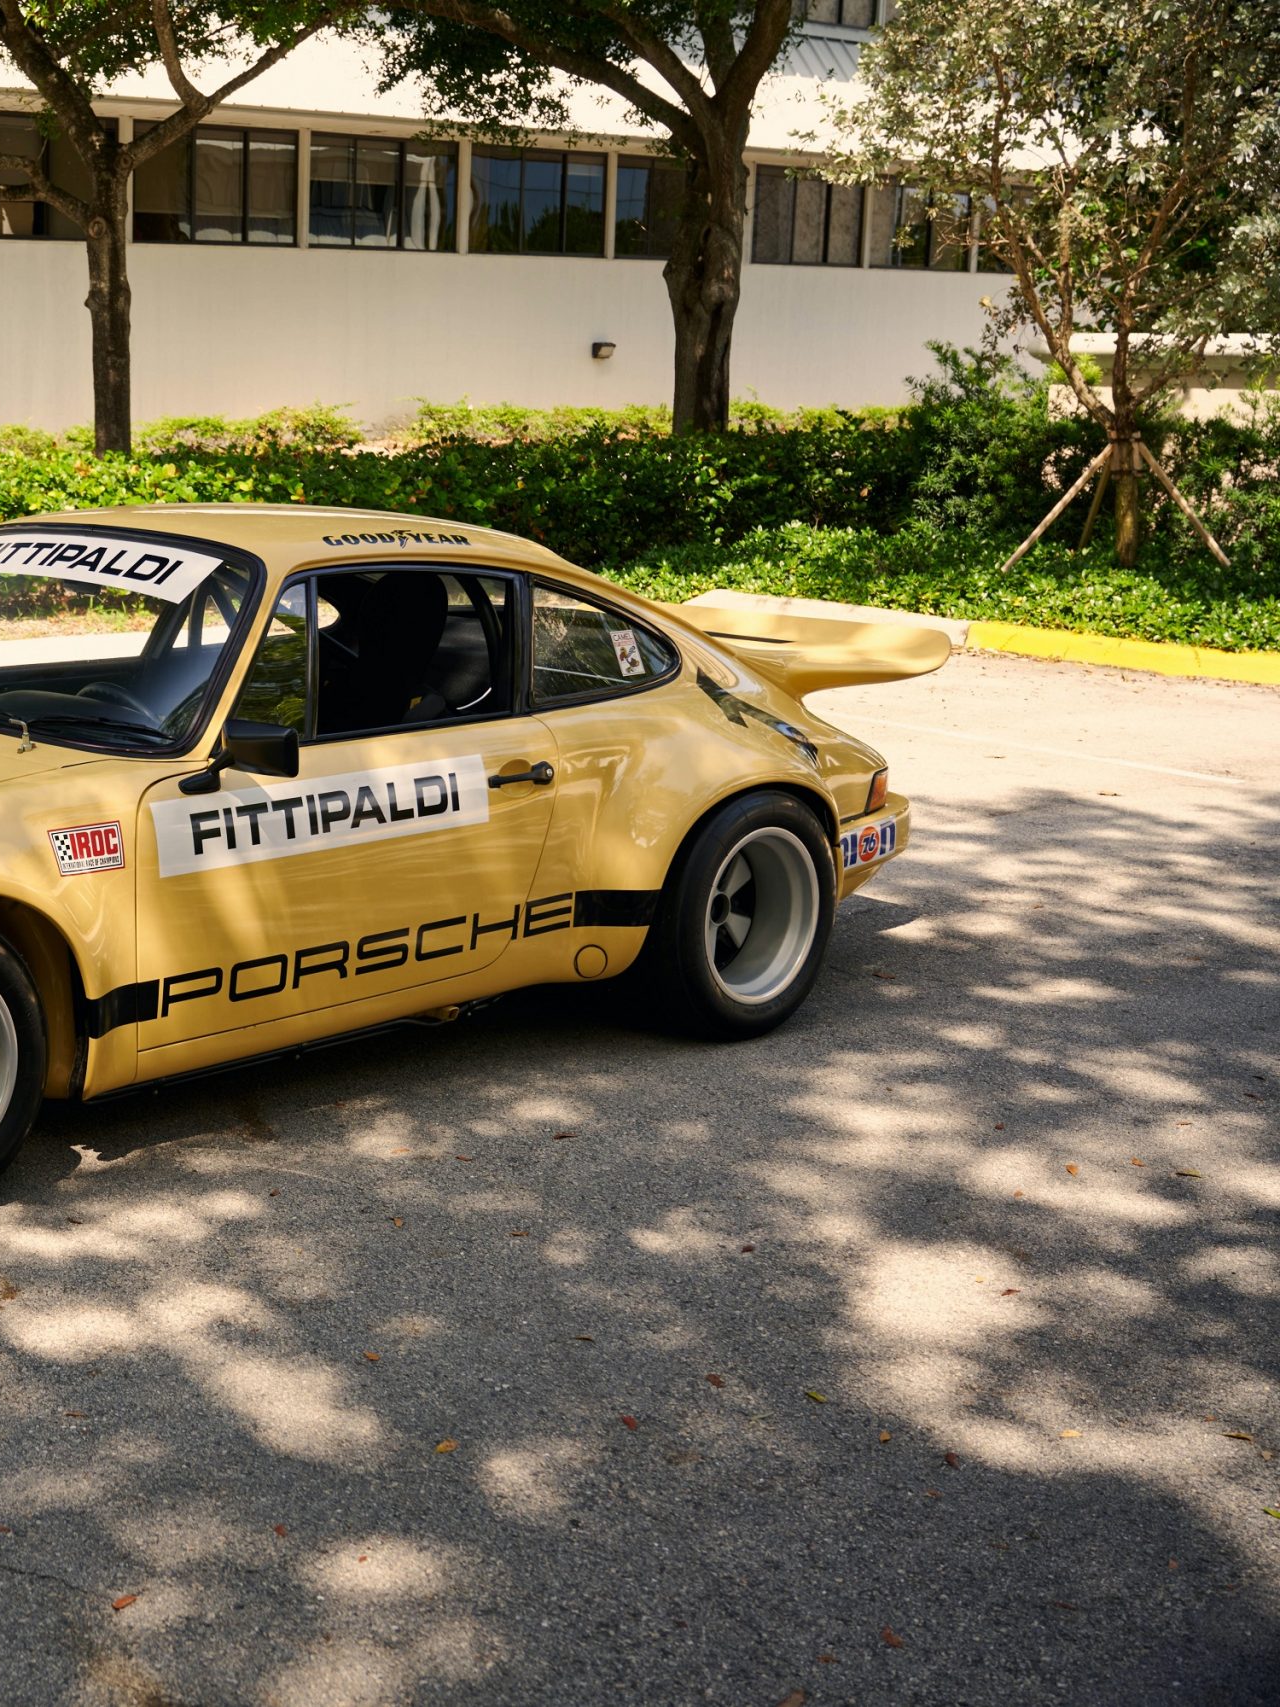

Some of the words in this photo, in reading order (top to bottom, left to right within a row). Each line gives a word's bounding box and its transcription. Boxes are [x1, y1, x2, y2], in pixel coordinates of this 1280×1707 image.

[322, 530, 471, 548] GOODYEAR
[189, 772, 461, 856] FITTIPALDI
[69, 828, 119, 860] IROC
[160, 892, 573, 1018] PORSCHE
